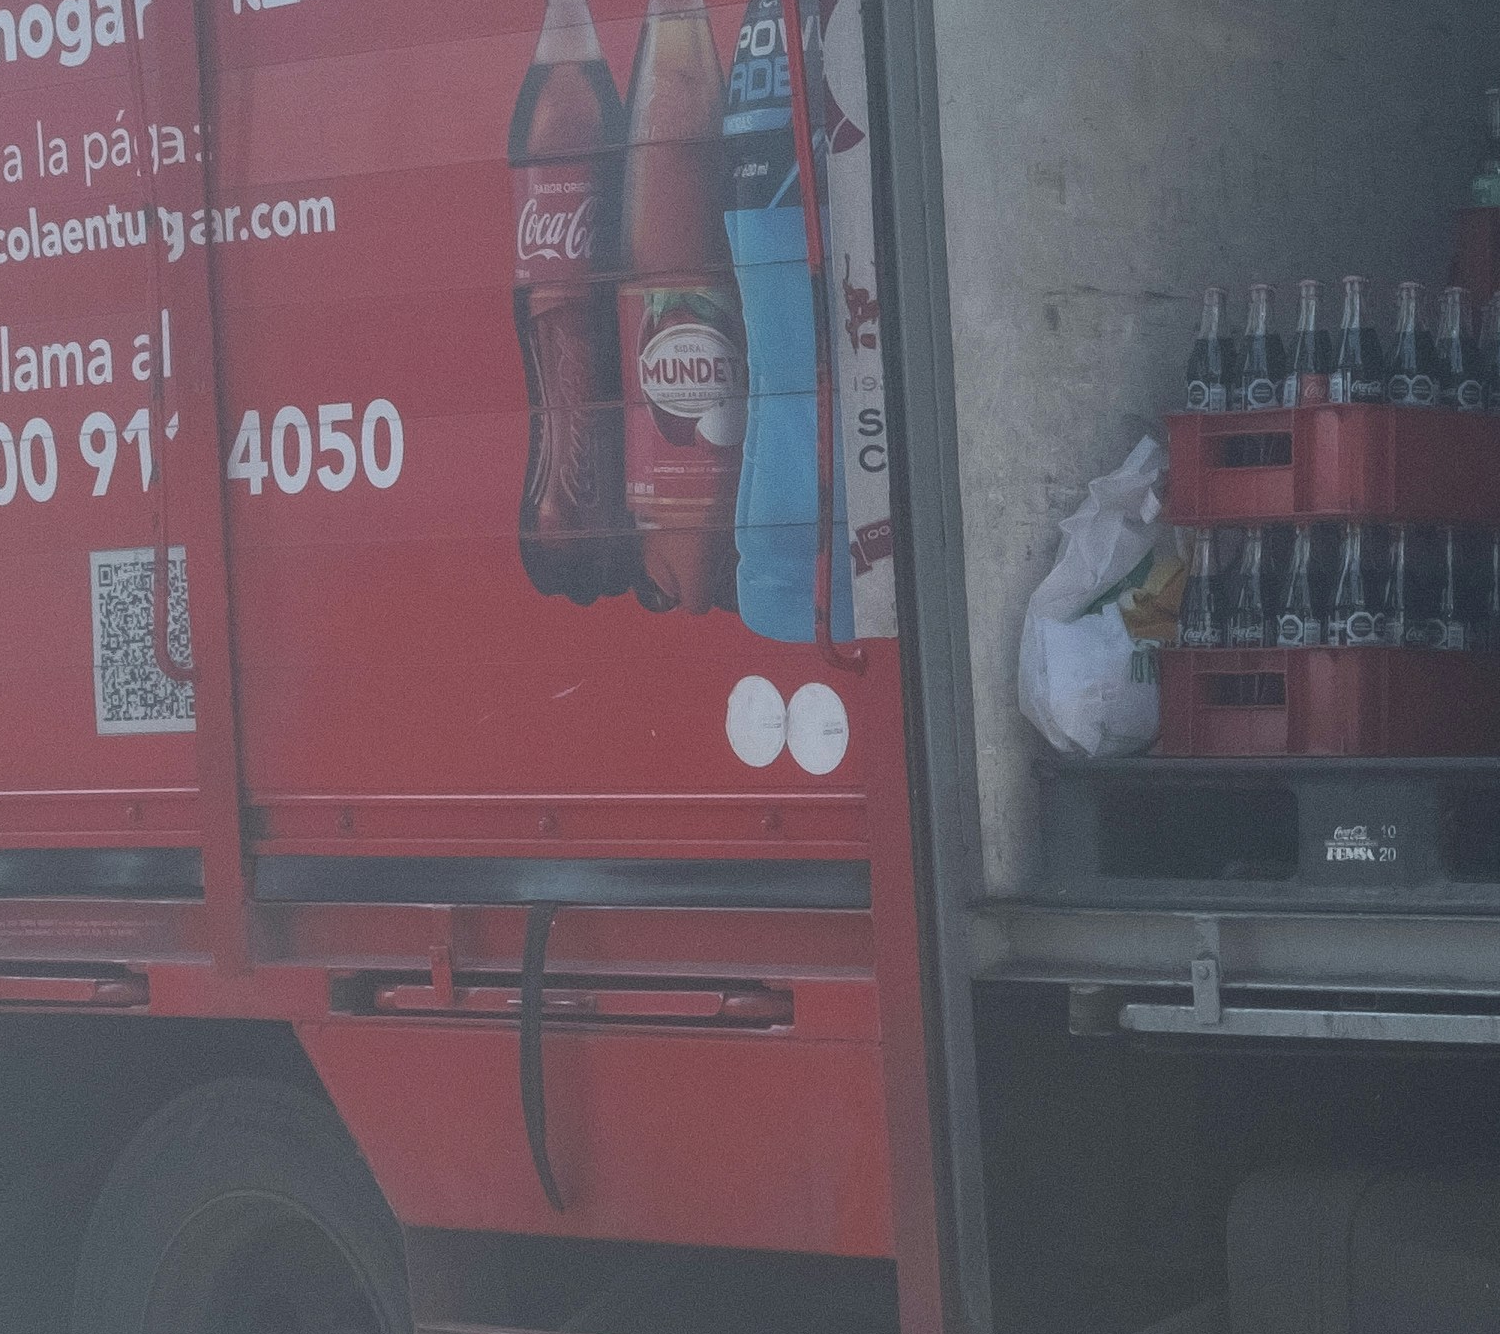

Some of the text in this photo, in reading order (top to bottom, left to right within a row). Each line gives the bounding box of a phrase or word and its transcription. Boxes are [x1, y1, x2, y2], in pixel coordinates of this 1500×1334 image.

[2, 145, 23, 183] a
[36, 119, 68, 179] la
[132, 308, 172, 382] al
[641, 356, 743, 385] MUNDET
[226, 398, 405, 496] 4050
[1380, 824, 1397, 839] 10
[1326, 846, 1376, 862] FEMSA
[1379, 846, 1397, 862] 20
